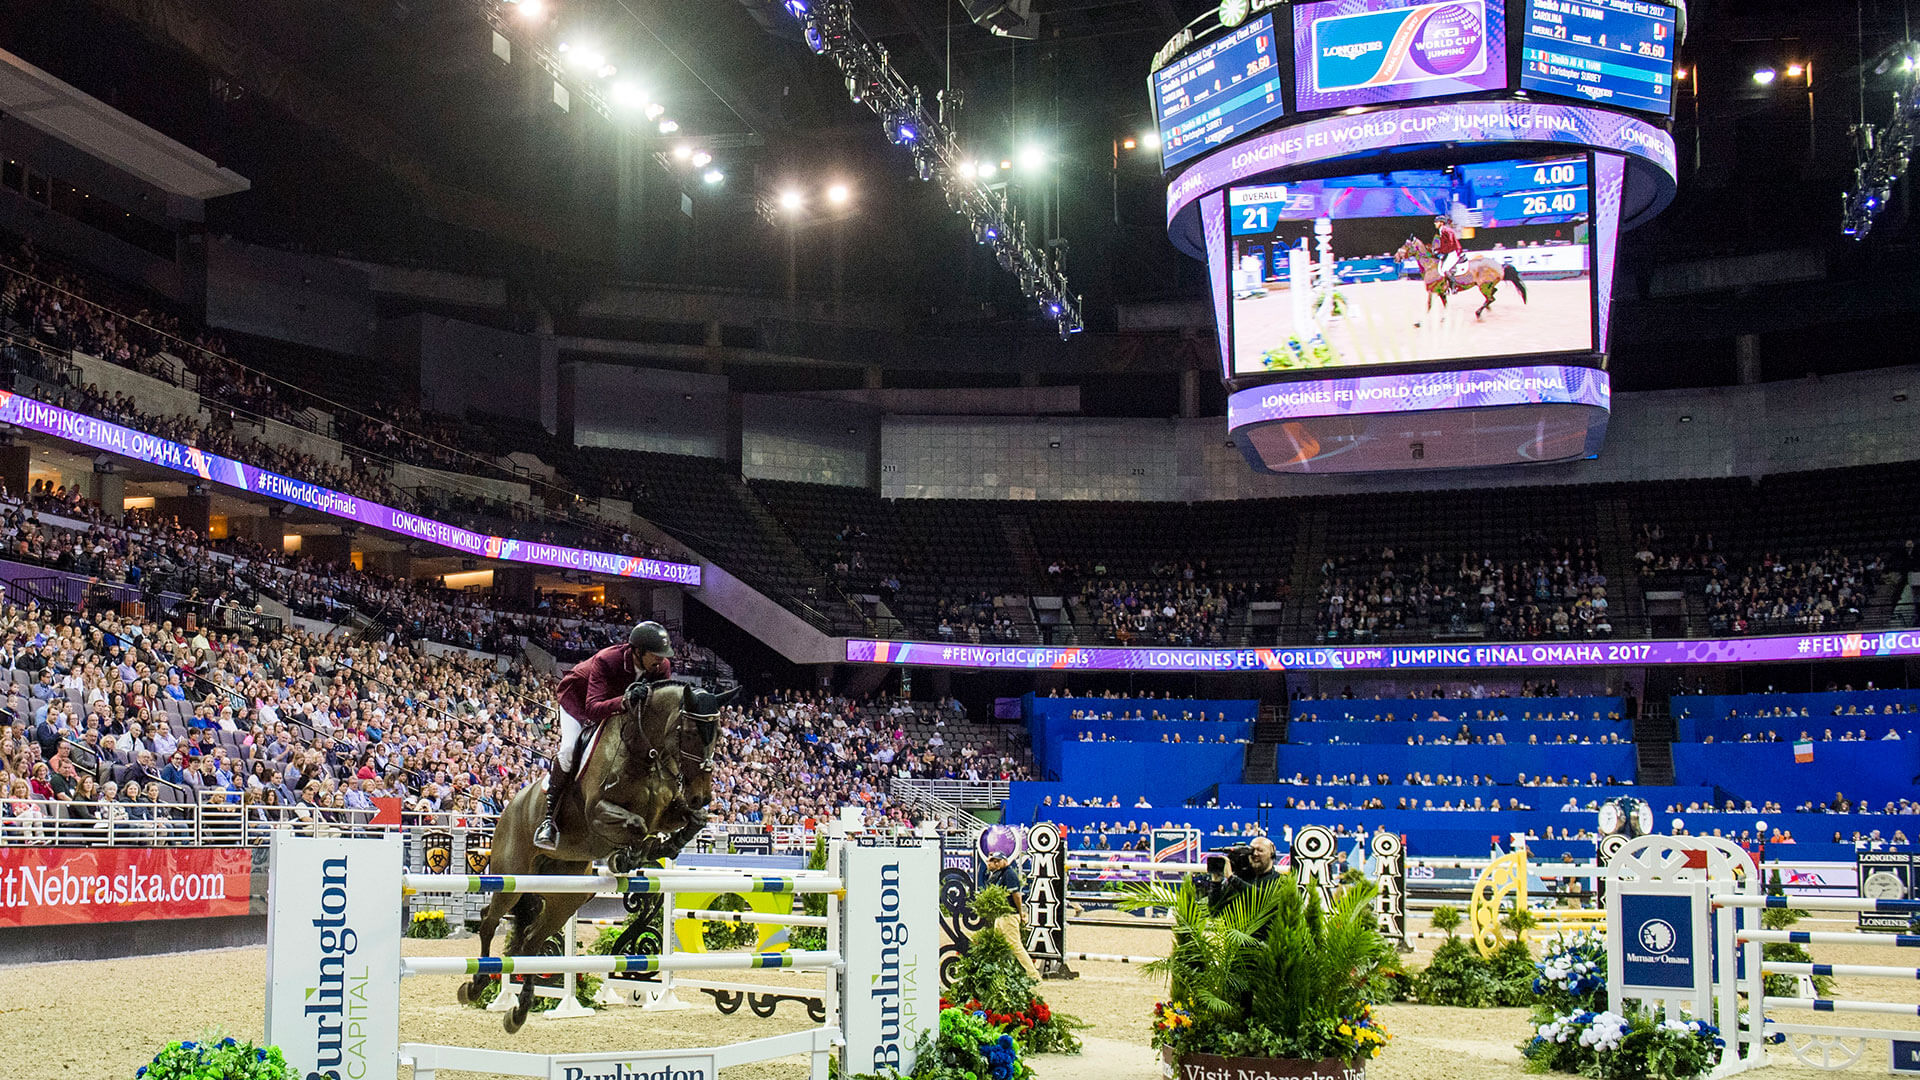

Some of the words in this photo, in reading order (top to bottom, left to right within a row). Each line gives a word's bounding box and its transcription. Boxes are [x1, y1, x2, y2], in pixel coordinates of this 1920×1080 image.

[1533, 10, 1562, 24] CAROLINA
[1649, 5, 1665, 17] 2017
[1249, 20, 1263, 33] 2017
[1323, 41, 1383, 58] LONGINES
[1415, 39, 1454, 51] WORLD
[1455, 36, 1477, 46] CUP
[1554, 25, 1567, 39] 21
[1599, 34, 1607, 46] 4
[1638, 41, 1665, 58] 26.60
[1427, 47, 1465, 60] JUMPING
[1180, 95, 1190, 108] 21
[1214, 79, 1221, 91] 4
[1247, 55, 1270, 76] 26.60
[1530, 62, 1536, 71] 2.
[1550, 66, 1580, 80] Christopher
[1231, 136, 1302, 170] LONGINES
[1306, 131, 1329, 148] FEI
[1330, 120, 1396, 144] WORLD
[1452, 113, 1531, 132] JUMPING
[1535, 115, 1579, 132] FINAL
[1620, 126, 1665, 155] LONGINES
[1533, 165, 1575, 184] 4.00
[1242, 190, 1279, 202] OVERALL
[1523, 193, 1576, 215] 26.40
[1242, 207, 1268, 229] 21
[1262, 391, 1331, 408] LONGINES
[1334, 389, 1353, 402] FEI
[1355, 387, 1410, 401] WORLD
[1453, 379, 1521, 396] JUMPING
[1524, 377, 1565, 391] FINAL
[17, 399, 84, 435] JUMPING
[88, 423, 128, 451] FINAL
[132, 435, 181, 465] OMAHA
[185, 449, 212, 473] 2017
[882, 465, 897, 473] 211
[1132, 468, 1145, 476] 212
[258, 472, 356, 516] #FEIWorldCupFinals
[392, 511, 436, 540] LONGINES
[438, 525, 450, 542] FEI
[452, 528, 481, 551] WORLD
[525, 545, 579, 566] JUMPING
[583, 553, 615, 570] FINAL
[618, 558, 661, 576] OMAHA
[663, 564, 688, 580] 2017
[1797, 633, 1920, 654] #FEIWorldCu
[942, 647, 1089, 667] #FEIWorldCupFinals
[1149, 652, 1232, 668] LONGINES
[1237, 650, 1260, 667] FEI
[1265, 650, 1326, 667] WORLD
[1390, 648, 1471, 668] JUMPING
[1475, 646, 1527, 663] FINAL
[1531, 645, 1603, 662] OMAHA
[1607, 645, 1651, 661] 2017
[730, 836, 769, 845] LONGINES
[1860, 854, 1909, 862] LONGINES
[1028, 823, 1060, 953] OMAHA
[1371, 833, 1401, 936] OMAHA
[872, 861, 909, 1073] Burlington
[1627, 953, 1654, 963] Mutual
[1661, 954, 1690, 965] Omaha
[904, 954, 918, 1051] CAPITAL
[347, 966, 369, 1079] CAPITAL
